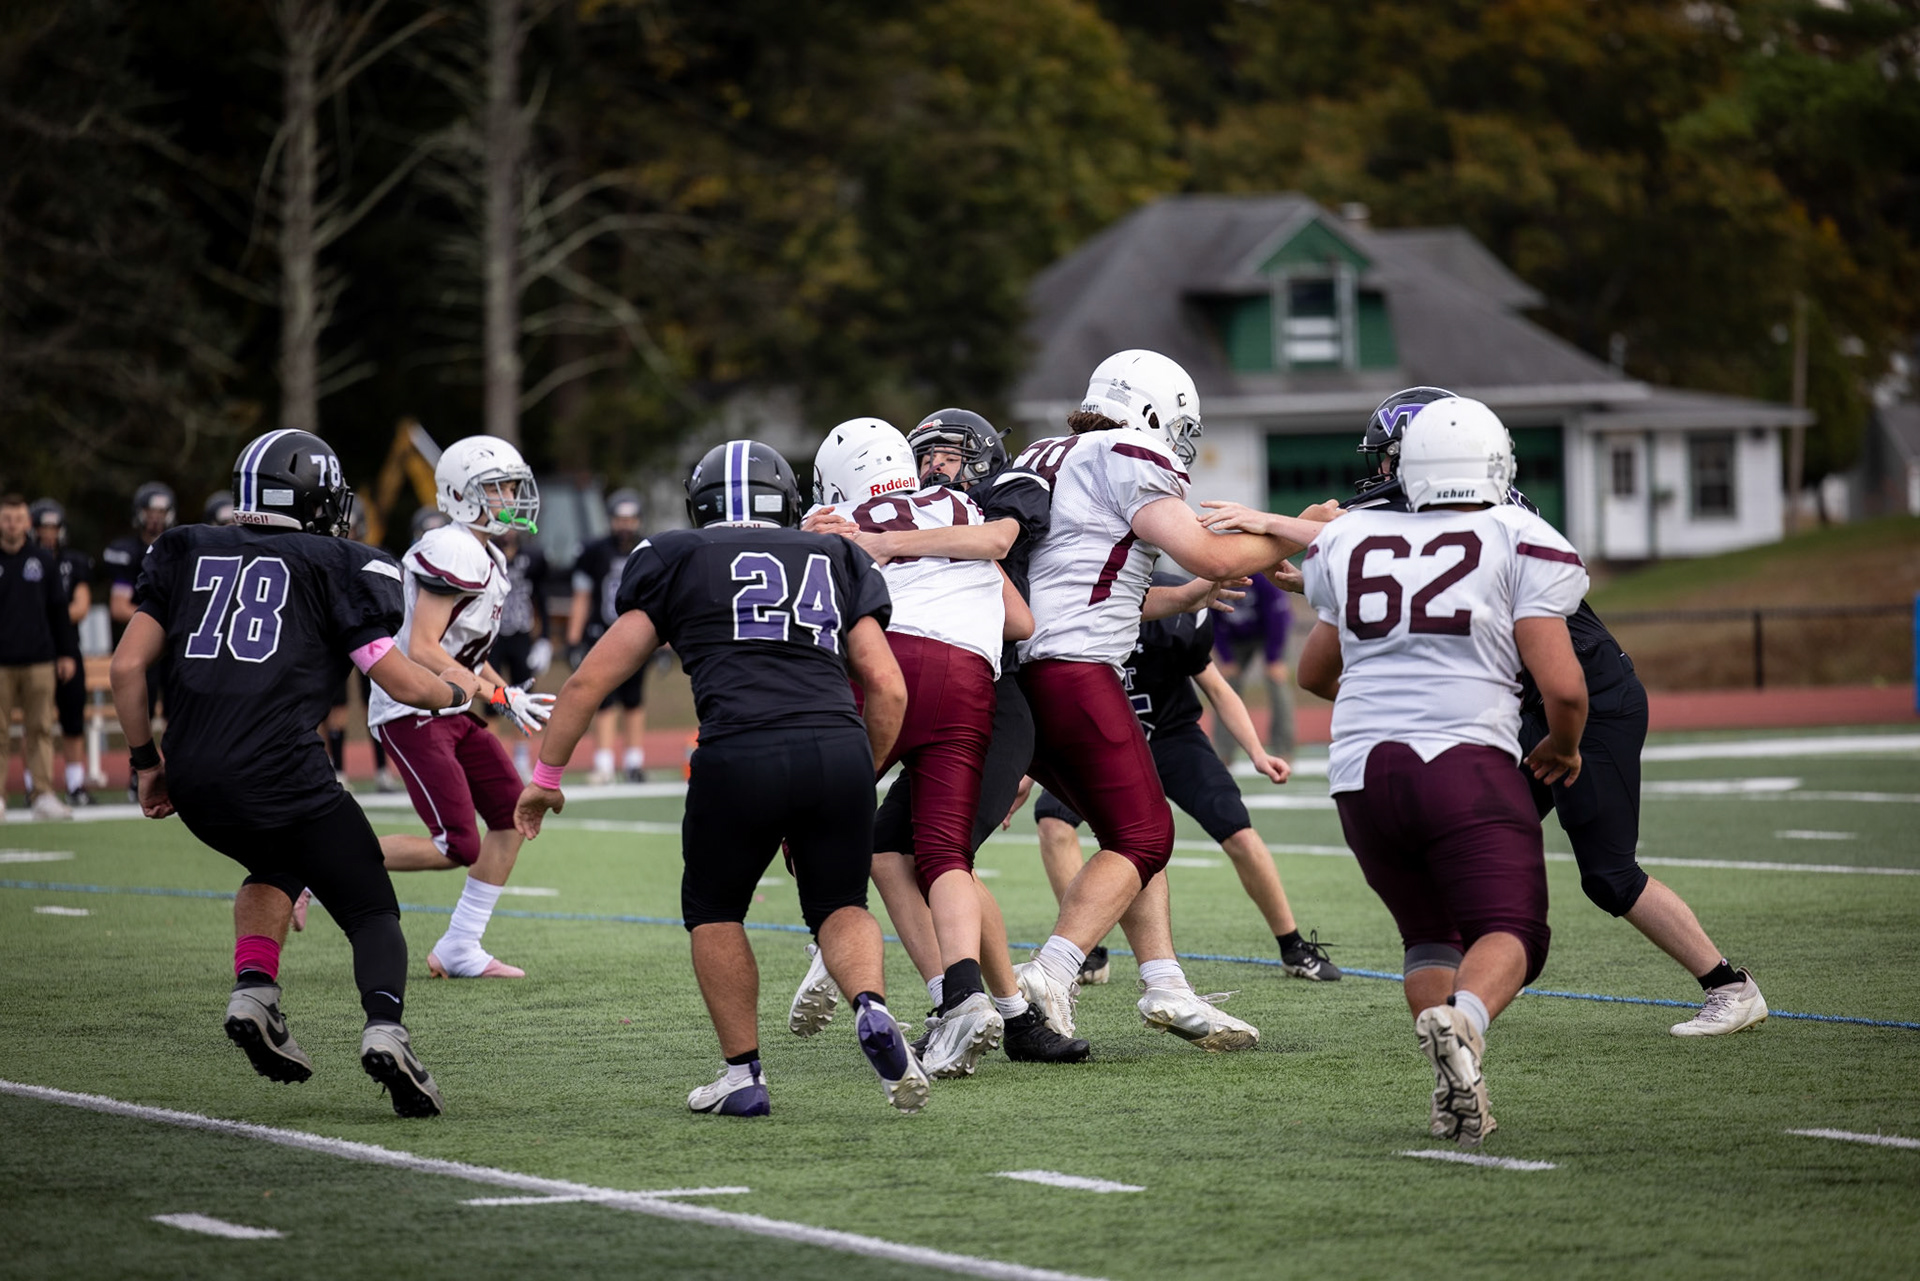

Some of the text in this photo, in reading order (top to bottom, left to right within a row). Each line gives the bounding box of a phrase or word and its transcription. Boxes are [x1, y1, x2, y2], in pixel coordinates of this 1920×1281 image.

[1081, 402, 1099, 411] chutt
[310, 454, 341, 488] 78
[870, 477, 915, 496] Riddell
[1436, 488, 1475, 498] schutt
[1345, 530, 1483, 641] 62
[184, 555, 290, 663] 78
[730, 552, 842, 655] 24
